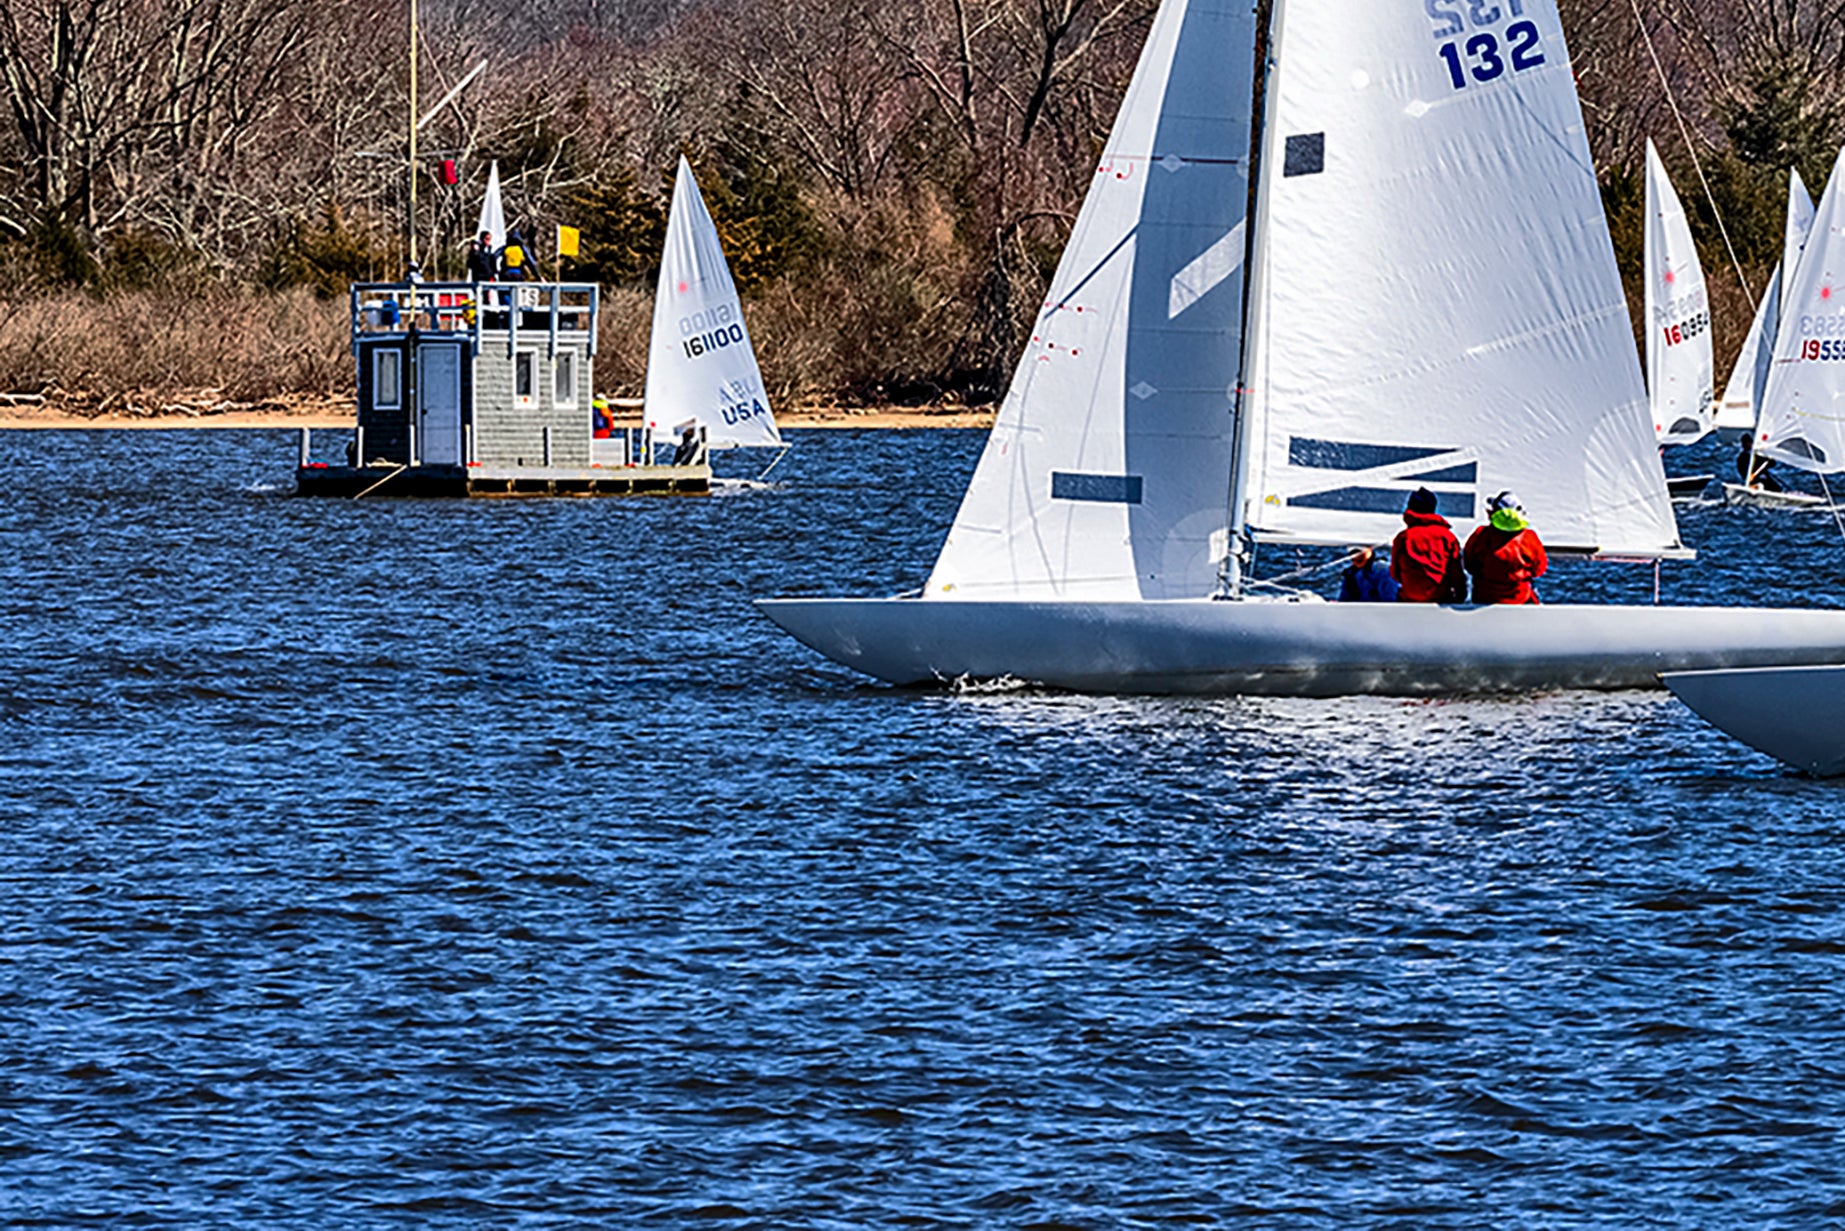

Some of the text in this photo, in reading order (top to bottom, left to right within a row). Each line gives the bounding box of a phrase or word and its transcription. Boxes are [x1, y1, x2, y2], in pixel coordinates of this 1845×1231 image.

[1439, 20, 1545, 89] 132
[682, 323, 744, 358] 161100
[721, 398, 766, 425] USA
